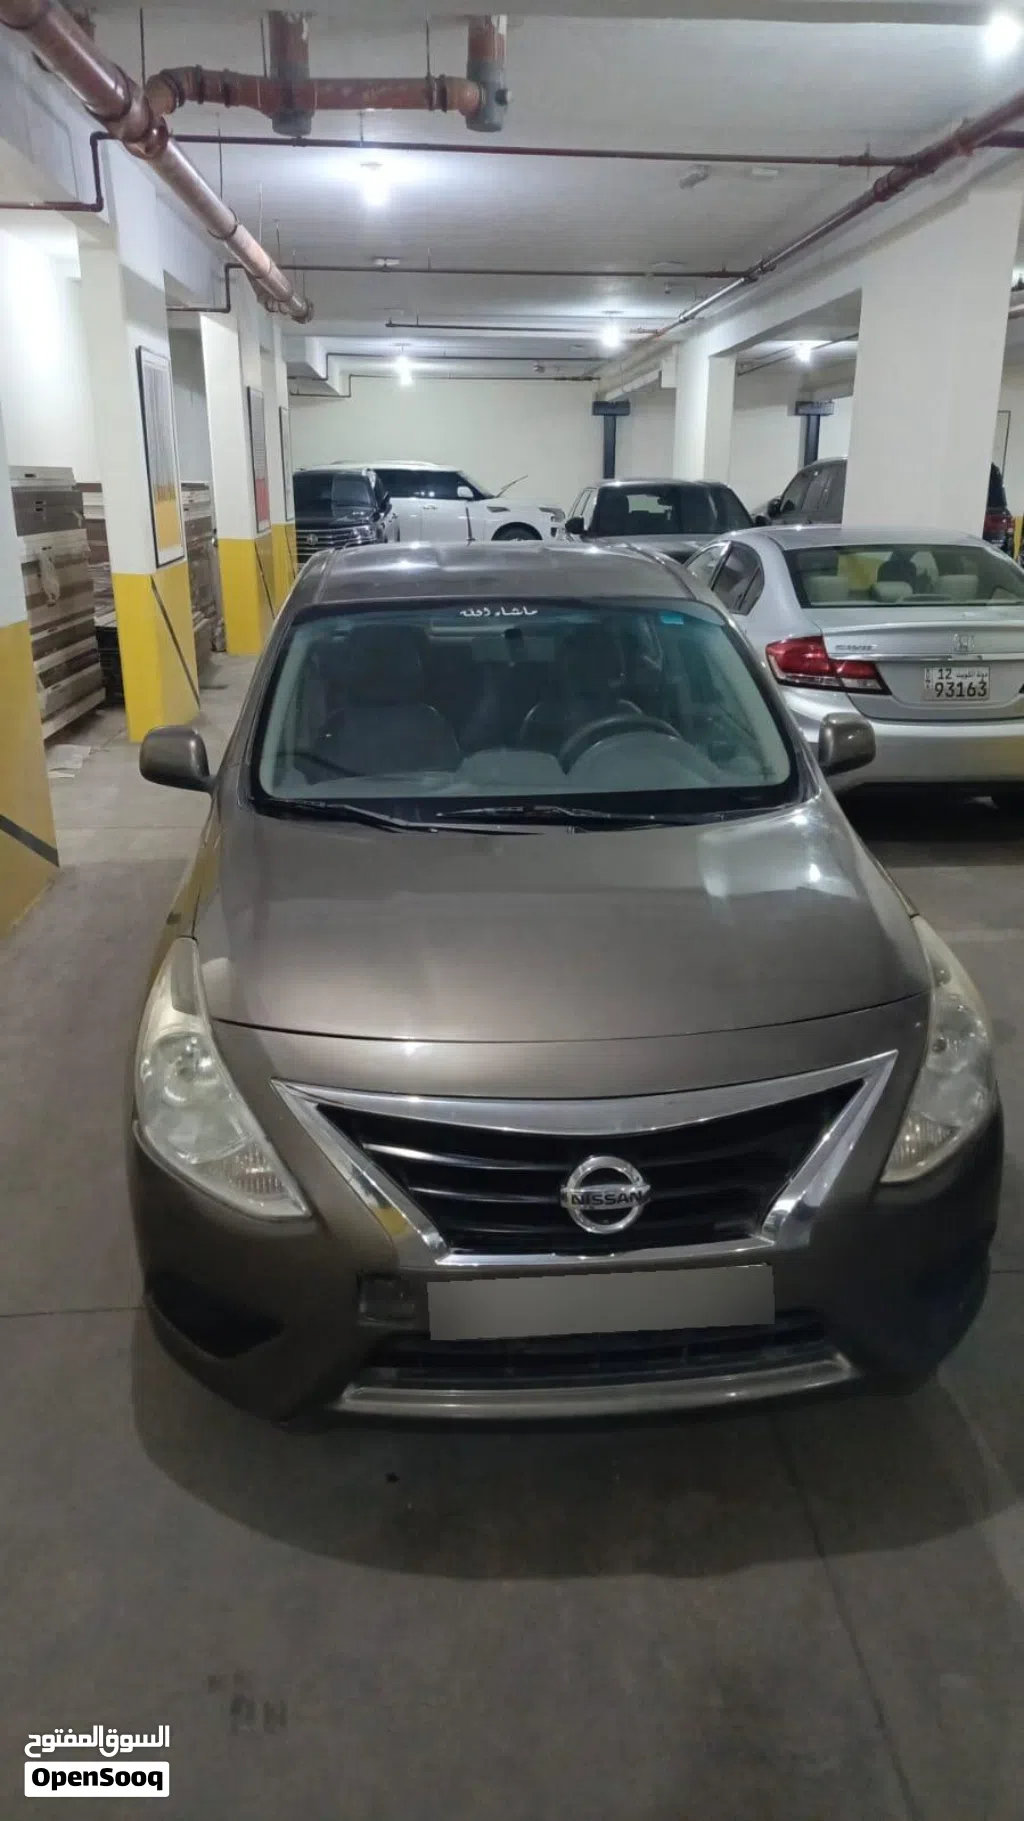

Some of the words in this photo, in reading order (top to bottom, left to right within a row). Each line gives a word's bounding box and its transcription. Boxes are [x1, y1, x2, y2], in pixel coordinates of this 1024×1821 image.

[938, 668, 952, 680] 12
[935, 681, 987, 697] 93163
[571, 1190, 642, 1206] NISSAN
